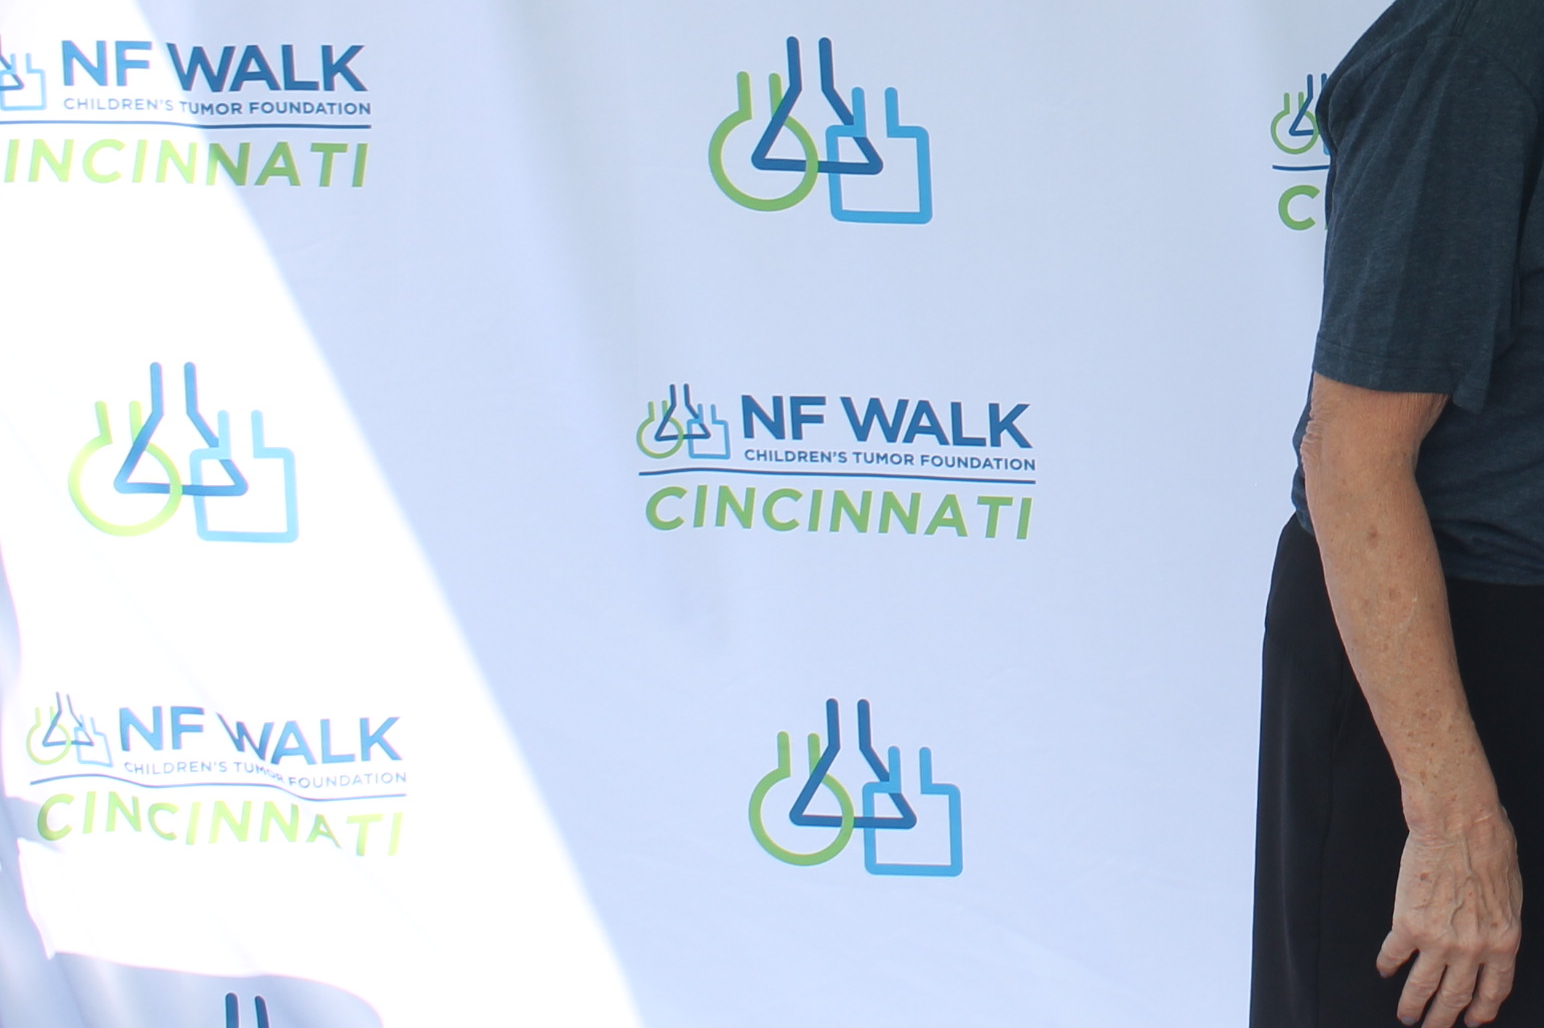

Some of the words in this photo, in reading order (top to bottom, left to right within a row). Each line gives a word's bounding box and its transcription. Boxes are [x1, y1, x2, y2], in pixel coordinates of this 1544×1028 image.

[61, 40, 152, 86] NF
[166, 42, 368, 92] WALK
[179, 101, 242, 116] TUMOR
[249, 101, 371, 116] FOUNDATION
[1278, 184, 1328, 230] C
[741, 395, 826, 441] NF
[840, 396, 1033, 449] WALK
[852, 451, 915, 466] TUMOR
[920, 454, 1036, 471] FOUNDATION
[645, 484, 1033, 540] CINCINNATI
[119, 706, 205, 752] NF
[214, 712, 402, 765] WALK
[233, 761, 285, 783] TUMOR
[288, 771, 407, 789] FOUNDATION
[37, 790, 403, 857] CINCINNATI
